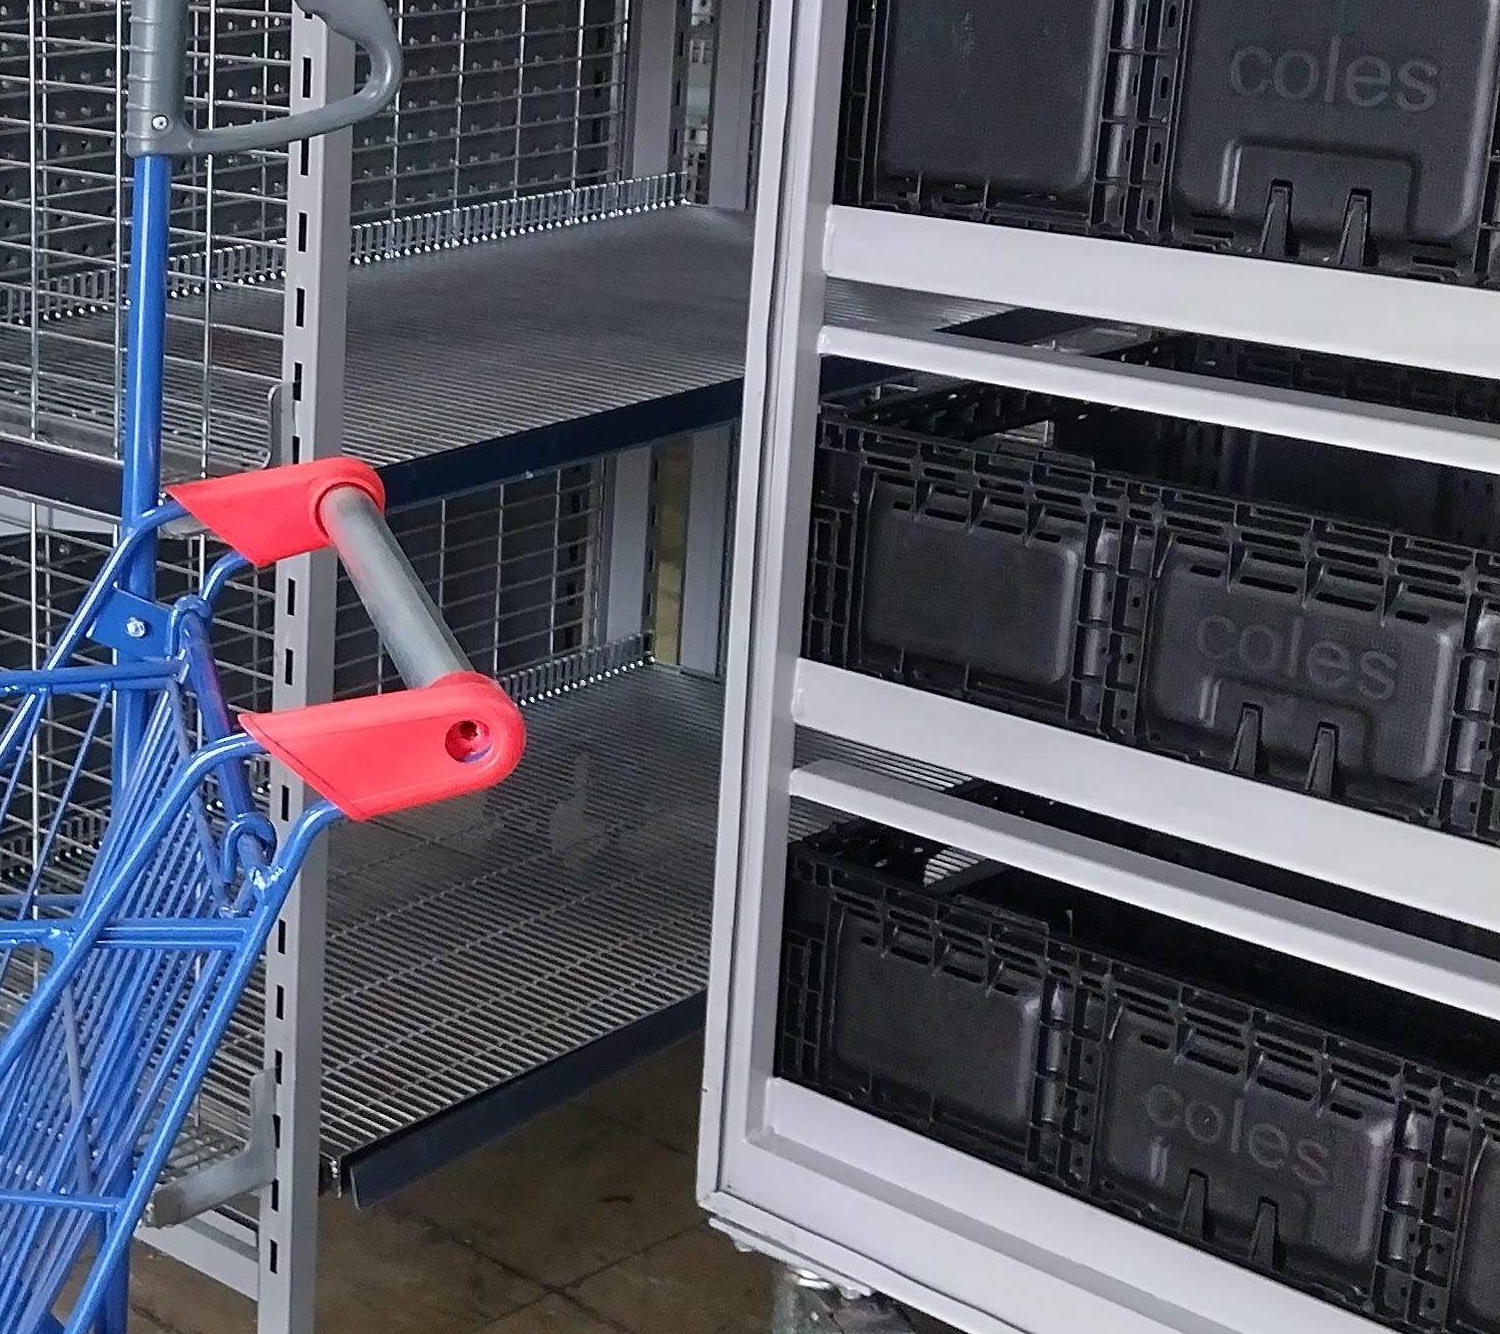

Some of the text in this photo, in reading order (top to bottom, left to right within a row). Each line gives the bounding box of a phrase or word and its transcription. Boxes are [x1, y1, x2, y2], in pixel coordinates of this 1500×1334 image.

[1230, 38, 1440, 113] coles
[1197, 615, 1397, 700] coles
[1146, 1083, 1331, 1186] coles
